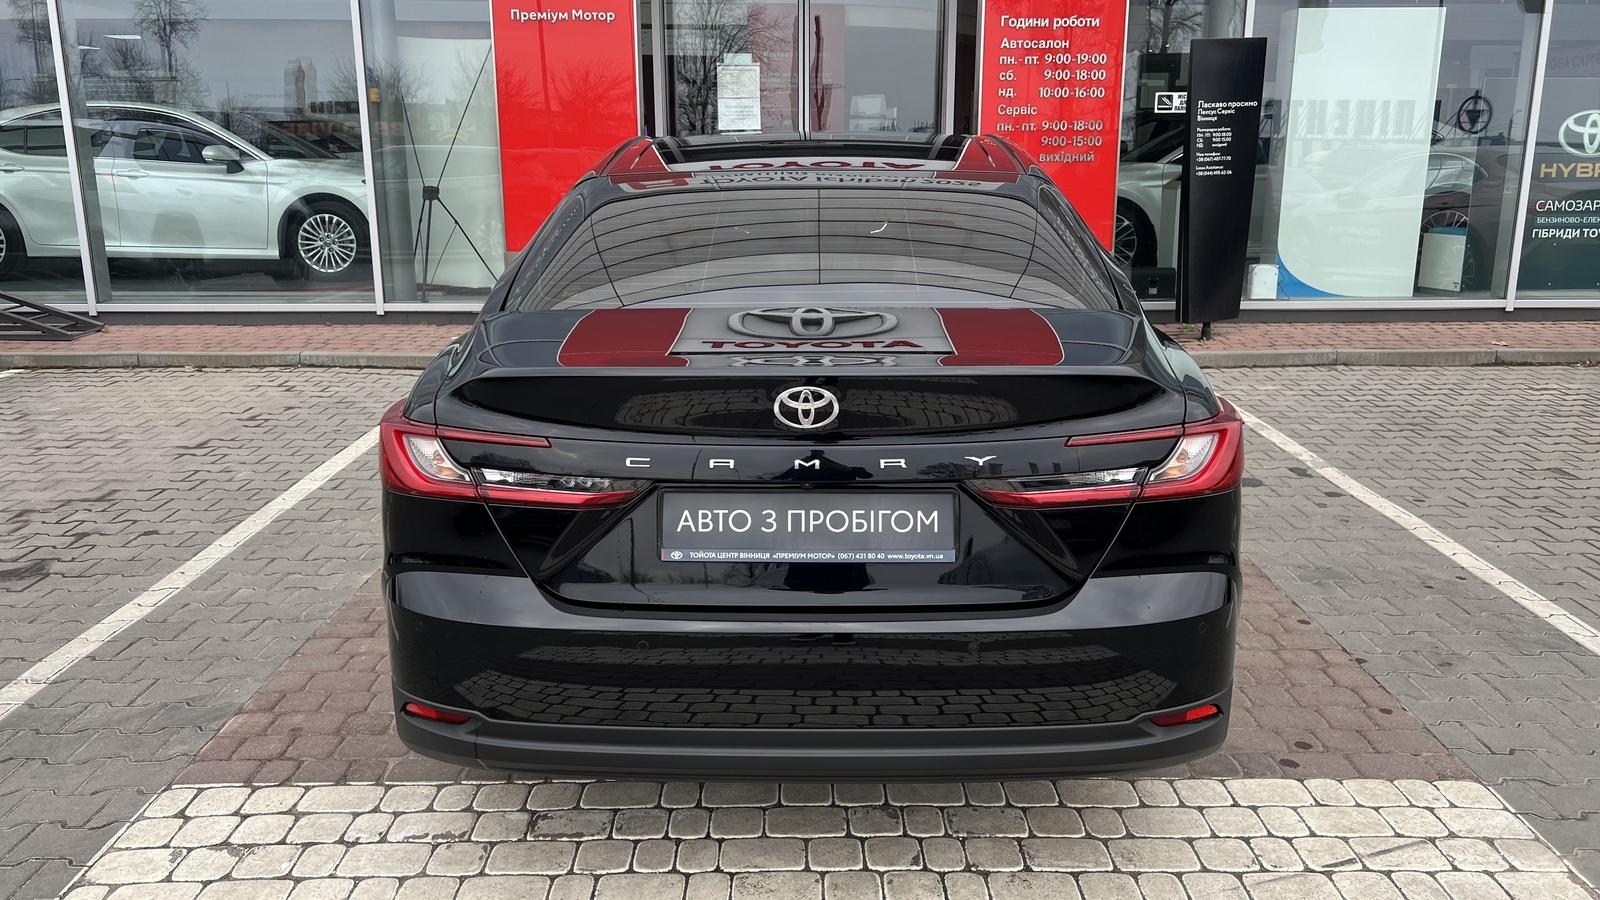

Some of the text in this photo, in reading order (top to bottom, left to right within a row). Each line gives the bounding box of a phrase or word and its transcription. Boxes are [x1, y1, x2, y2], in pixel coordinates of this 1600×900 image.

[510, 9, 616, 24] Преміум Мотор
[1000, 14, 1100, 30] Години роботи
[1000, 37, 1070, 49] Автосалон
[1044, 53, 1107, 65] 9:00-19:00
[999, 69, 1107, 81] сб. 9:00-18:00
[998, 86, 1106, 98] нд. 10:00-16:00
[997, 103, 1038, 117] Сервіс
[1197, 100, 1228, 109] Ласкаво
[1227, 101, 1258, 109] просимо
[1041, 119, 1103, 132] 9:00-18:00
[1041, 135, 1102, 147] 9:00-15:00
[1039, 150, 1095, 163] вихідний
[1531, 227, 1580, 240] ГІБРИДИ
[701, 340, 924, 349] TOYOTA
[625, 455, 997, 470] CAMRY
[676, 509, 939, 533] АВТО З ПРОБІГОМ
[689, 550, 716, 559] ТОЙОТА
[717, 552, 739, 560] ЦЕНТР
[739, 552, 770, 560] ВІННИЦЯ
[867, 552, 876, 560] 80
[876, 552, 886, 560] 40
[887, 552, 944, 561] www.toyota.vn.ua
